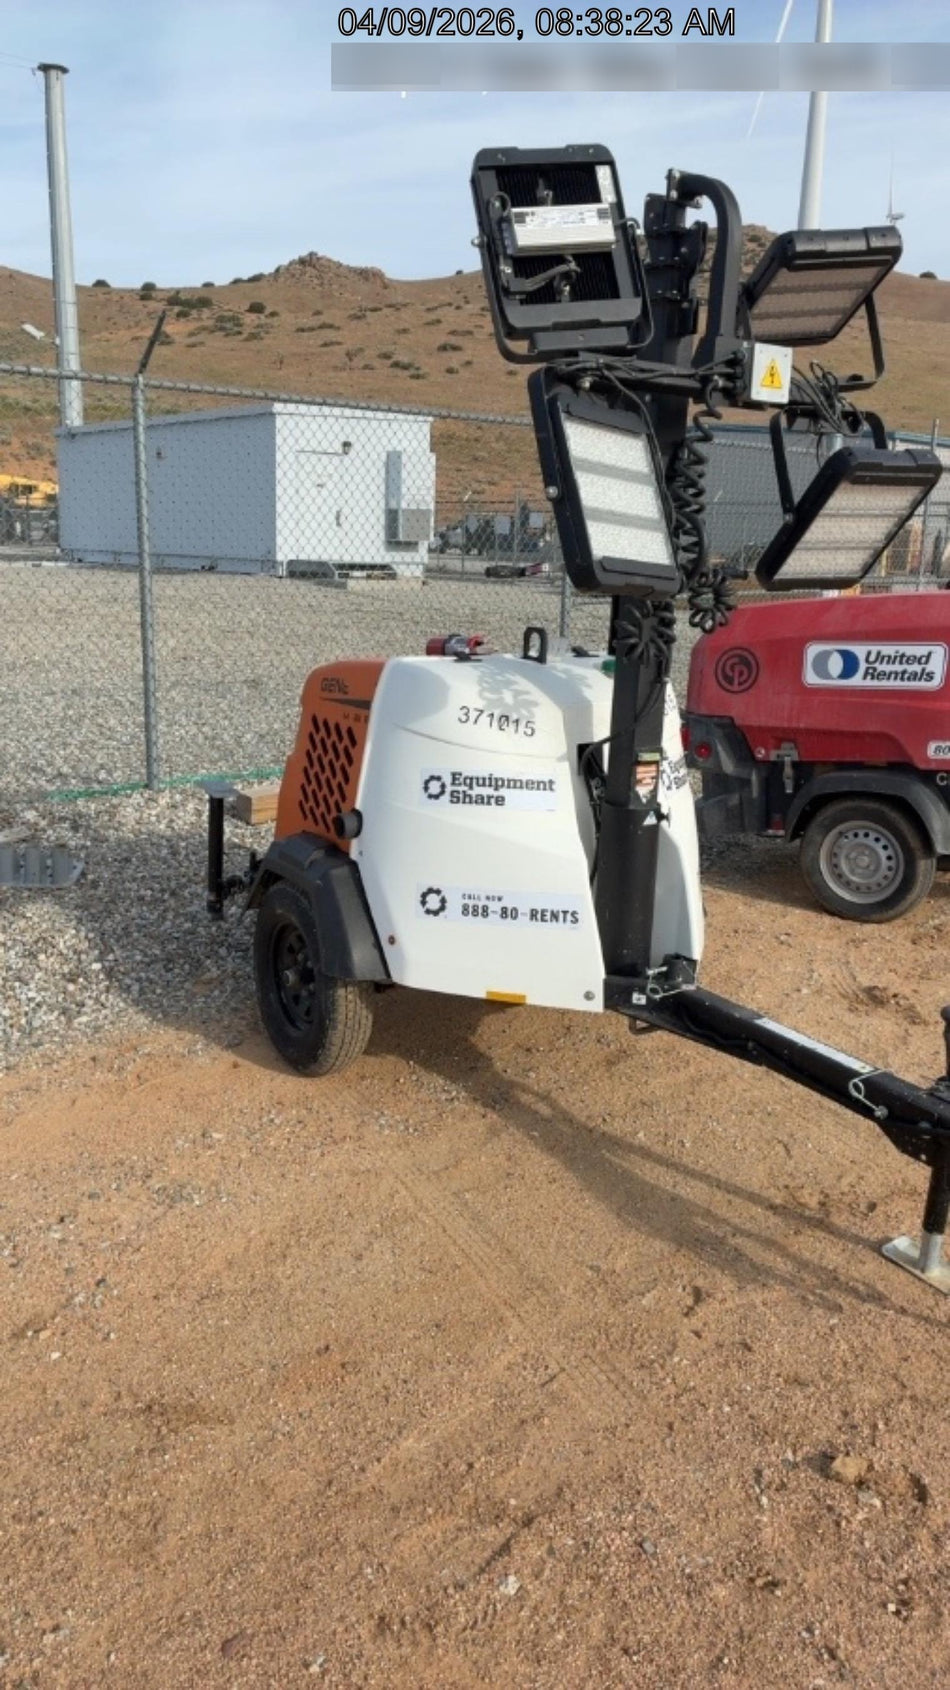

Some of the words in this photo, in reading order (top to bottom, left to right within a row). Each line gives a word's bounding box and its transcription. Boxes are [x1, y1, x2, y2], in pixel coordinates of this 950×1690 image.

[865, 650, 932, 666] United
[863, 667, 935, 682] Rentals
[458, 706, 536, 737] 371015
[450, 772, 556, 792] Equipment
[450, 790, 506, 806] Share
[461, 903, 579, 925] 888-80-RENTS
